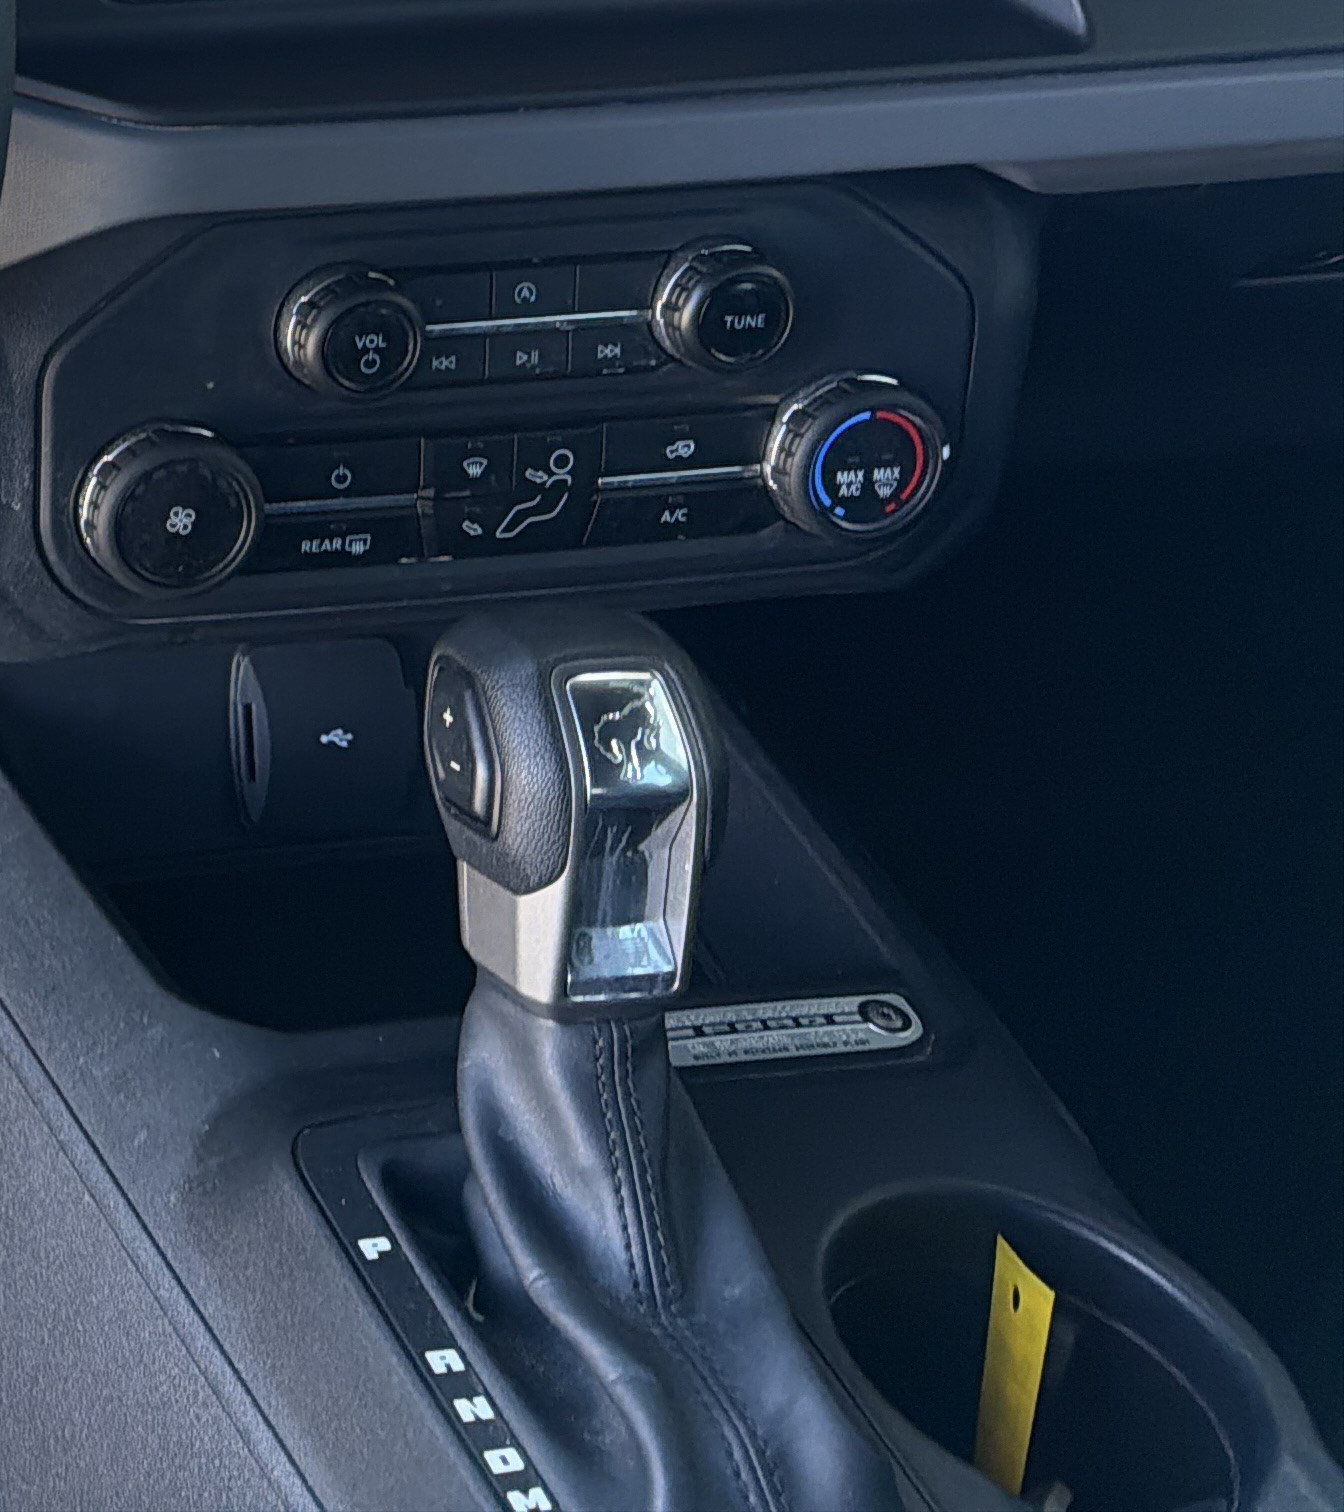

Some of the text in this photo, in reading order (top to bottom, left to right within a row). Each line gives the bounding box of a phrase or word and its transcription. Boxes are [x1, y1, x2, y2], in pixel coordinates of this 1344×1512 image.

[724, 313, 767, 330] TUNE
[354, 332, 387, 351] VOL
[836, 469, 865, 485] MAX
[872, 466, 901, 483] MAX
[838, 482, 862, 498] A/C
[660, 508, 689, 524] A/C
[301, 536, 343, 554] REAR
[357, 1236, 392, 1261] P
[453, 1395, 495, 1423] N
[506, 1486, 552, 1512] M
